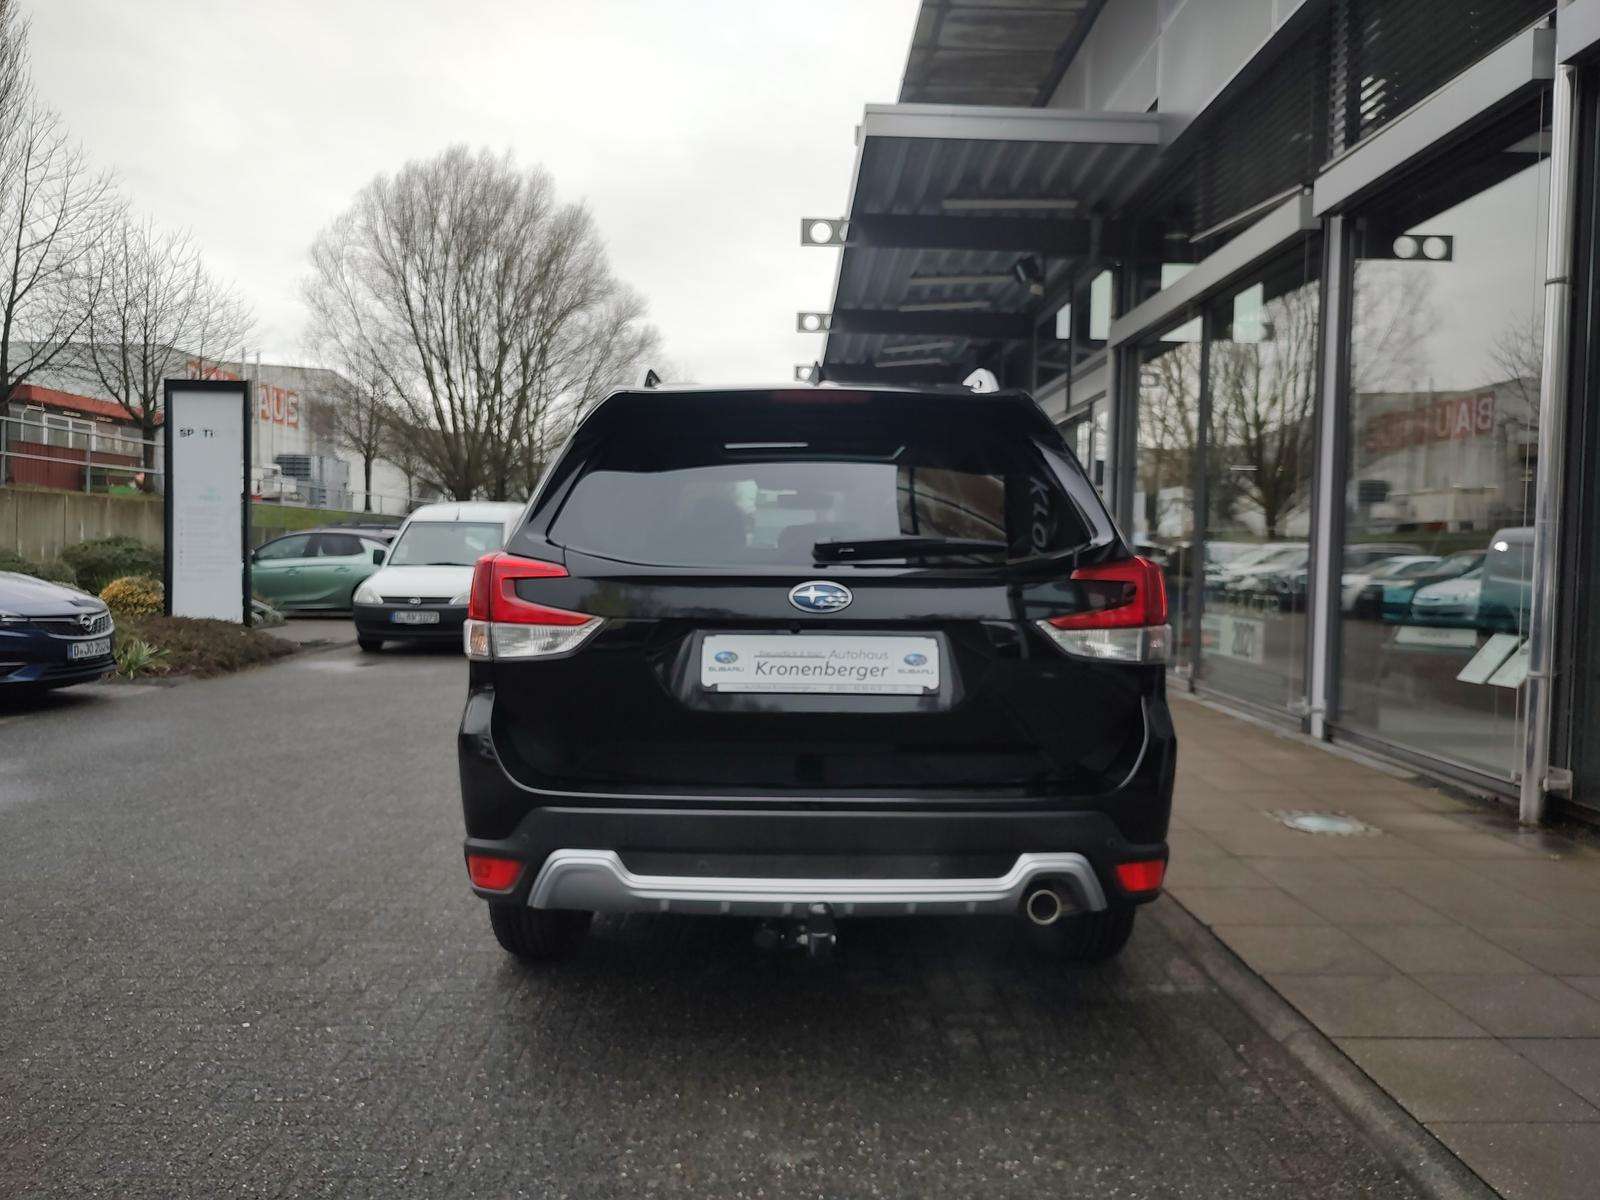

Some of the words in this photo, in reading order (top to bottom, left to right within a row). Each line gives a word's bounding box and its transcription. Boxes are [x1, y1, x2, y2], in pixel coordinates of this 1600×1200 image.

[828, 649, 889, 660] Autohaus
[708, 665, 745, 673] SUBARU
[755, 660, 889, 681] Kronenberger
[897, 668, 935, 676] SUBARU
